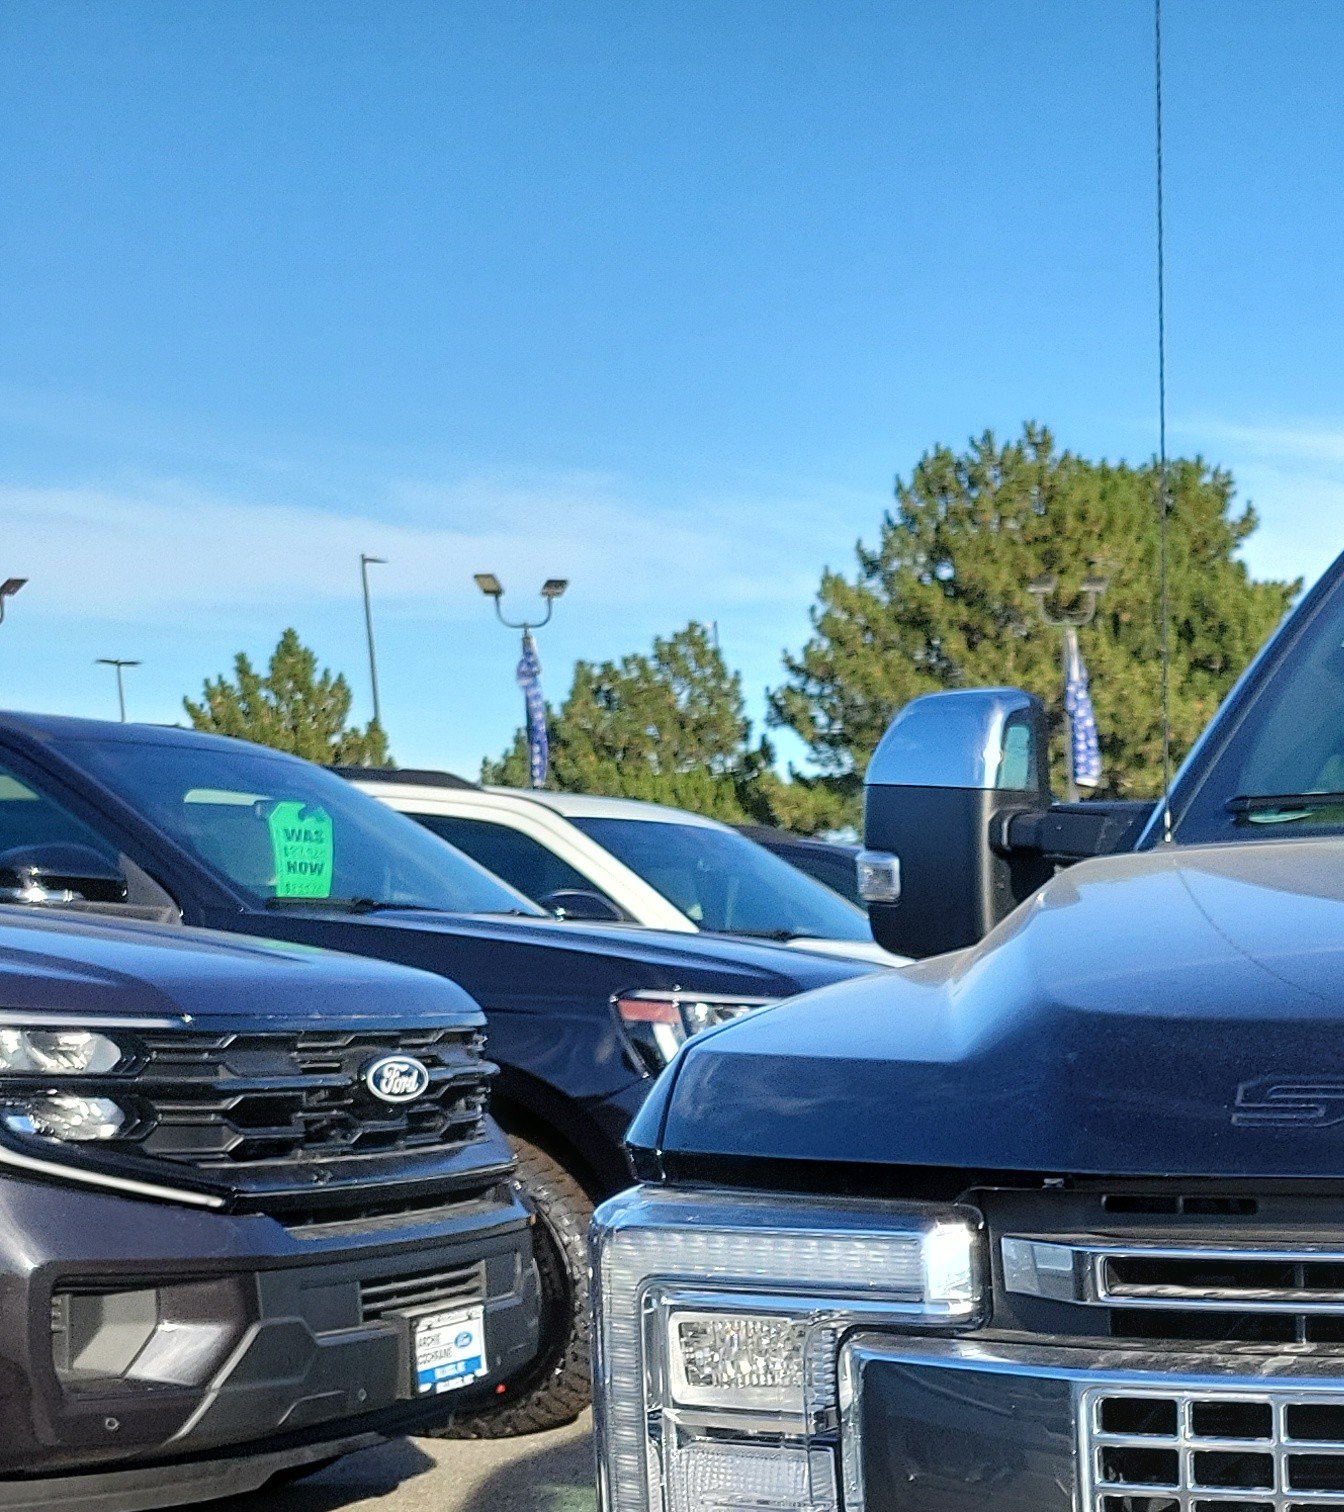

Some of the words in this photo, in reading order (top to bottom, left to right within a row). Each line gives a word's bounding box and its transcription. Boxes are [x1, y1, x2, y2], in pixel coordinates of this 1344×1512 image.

[284, 828, 324, 844] WAS
[287, 861, 325, 876] NOW
[380, 1063, 419, 1094] Ford
